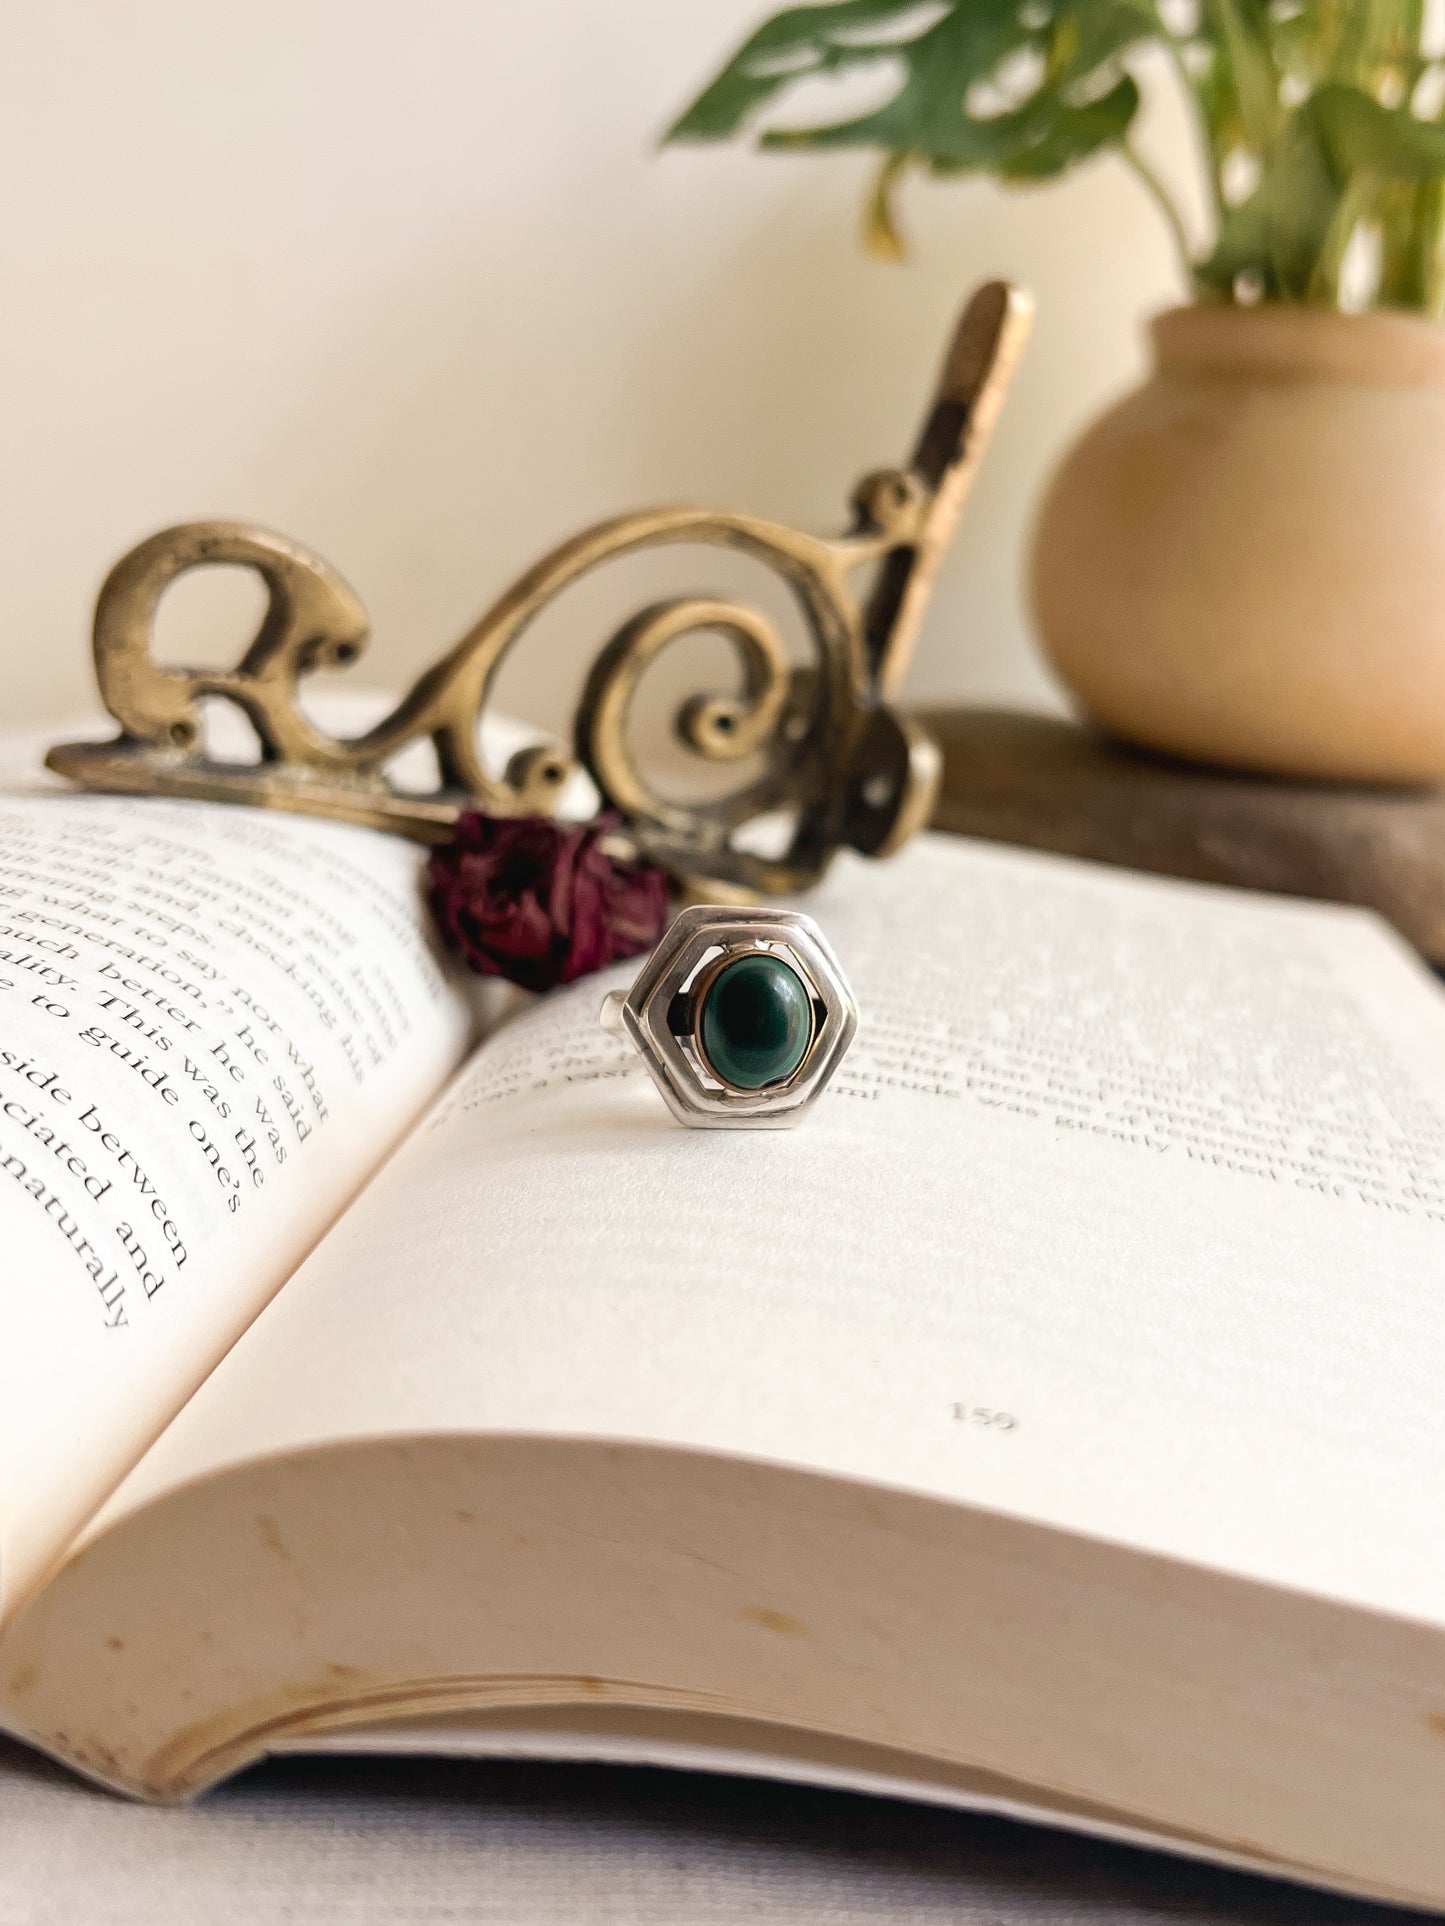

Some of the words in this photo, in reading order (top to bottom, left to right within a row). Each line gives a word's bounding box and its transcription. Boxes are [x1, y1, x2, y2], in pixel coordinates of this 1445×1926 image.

[31, 994, 71, 1018] to
[78, 1026, 180, 1107] guide
[40, 892, 125, 927] what
[131, 926, 169, 947] to
[176, 948, 226, 980] say
[231, 985, 284, 1034] nor
[287, 1038, 330, 1124] what
[97, 961, 203, 1033] better
[209, 1039, 246, 1083] he
[255, 1093, 288, 1165] was
[214, 917, 337, 1030] checking
[96, 989, 174, 1052] This
[183, 1054, 233, 1120] was
[233, 1125, 266, 1190] the
[234, 1023, 269, 1066] he
[272, 1074, 313, 1144] said
[0, 1090, 114, 1204] ciated
[115, 1220, 166, 1302] and
[77, 1103, 188, 1272] between
